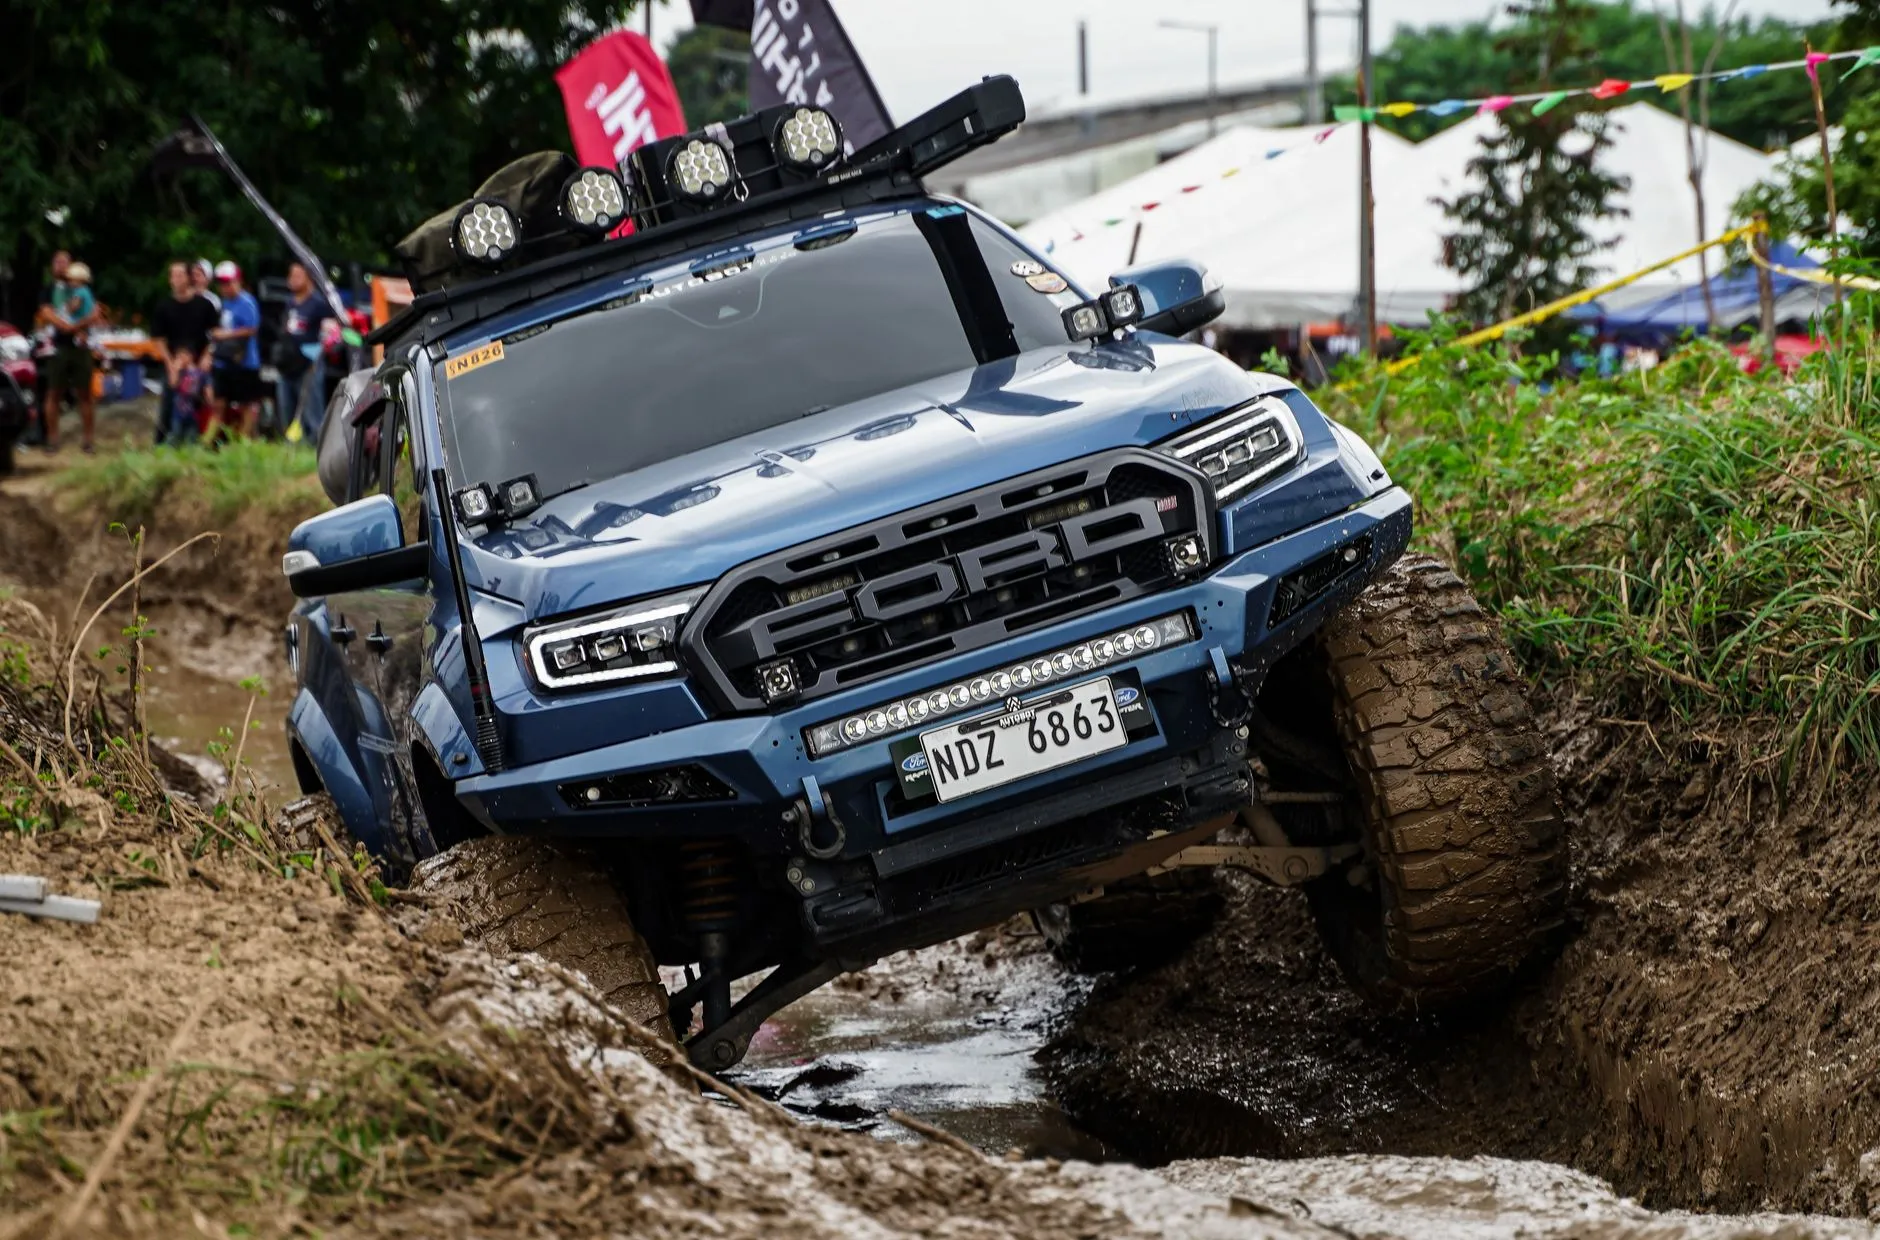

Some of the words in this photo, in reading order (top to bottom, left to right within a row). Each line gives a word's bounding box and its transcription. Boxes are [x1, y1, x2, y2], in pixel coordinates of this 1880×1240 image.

[749, 497, 1165, 656] FORD
[931, 729, 1005, 784] NDZ
[1028, 695, 1115, 754] 6863
[1000, 708, 1036, 729] AUTOBOT
